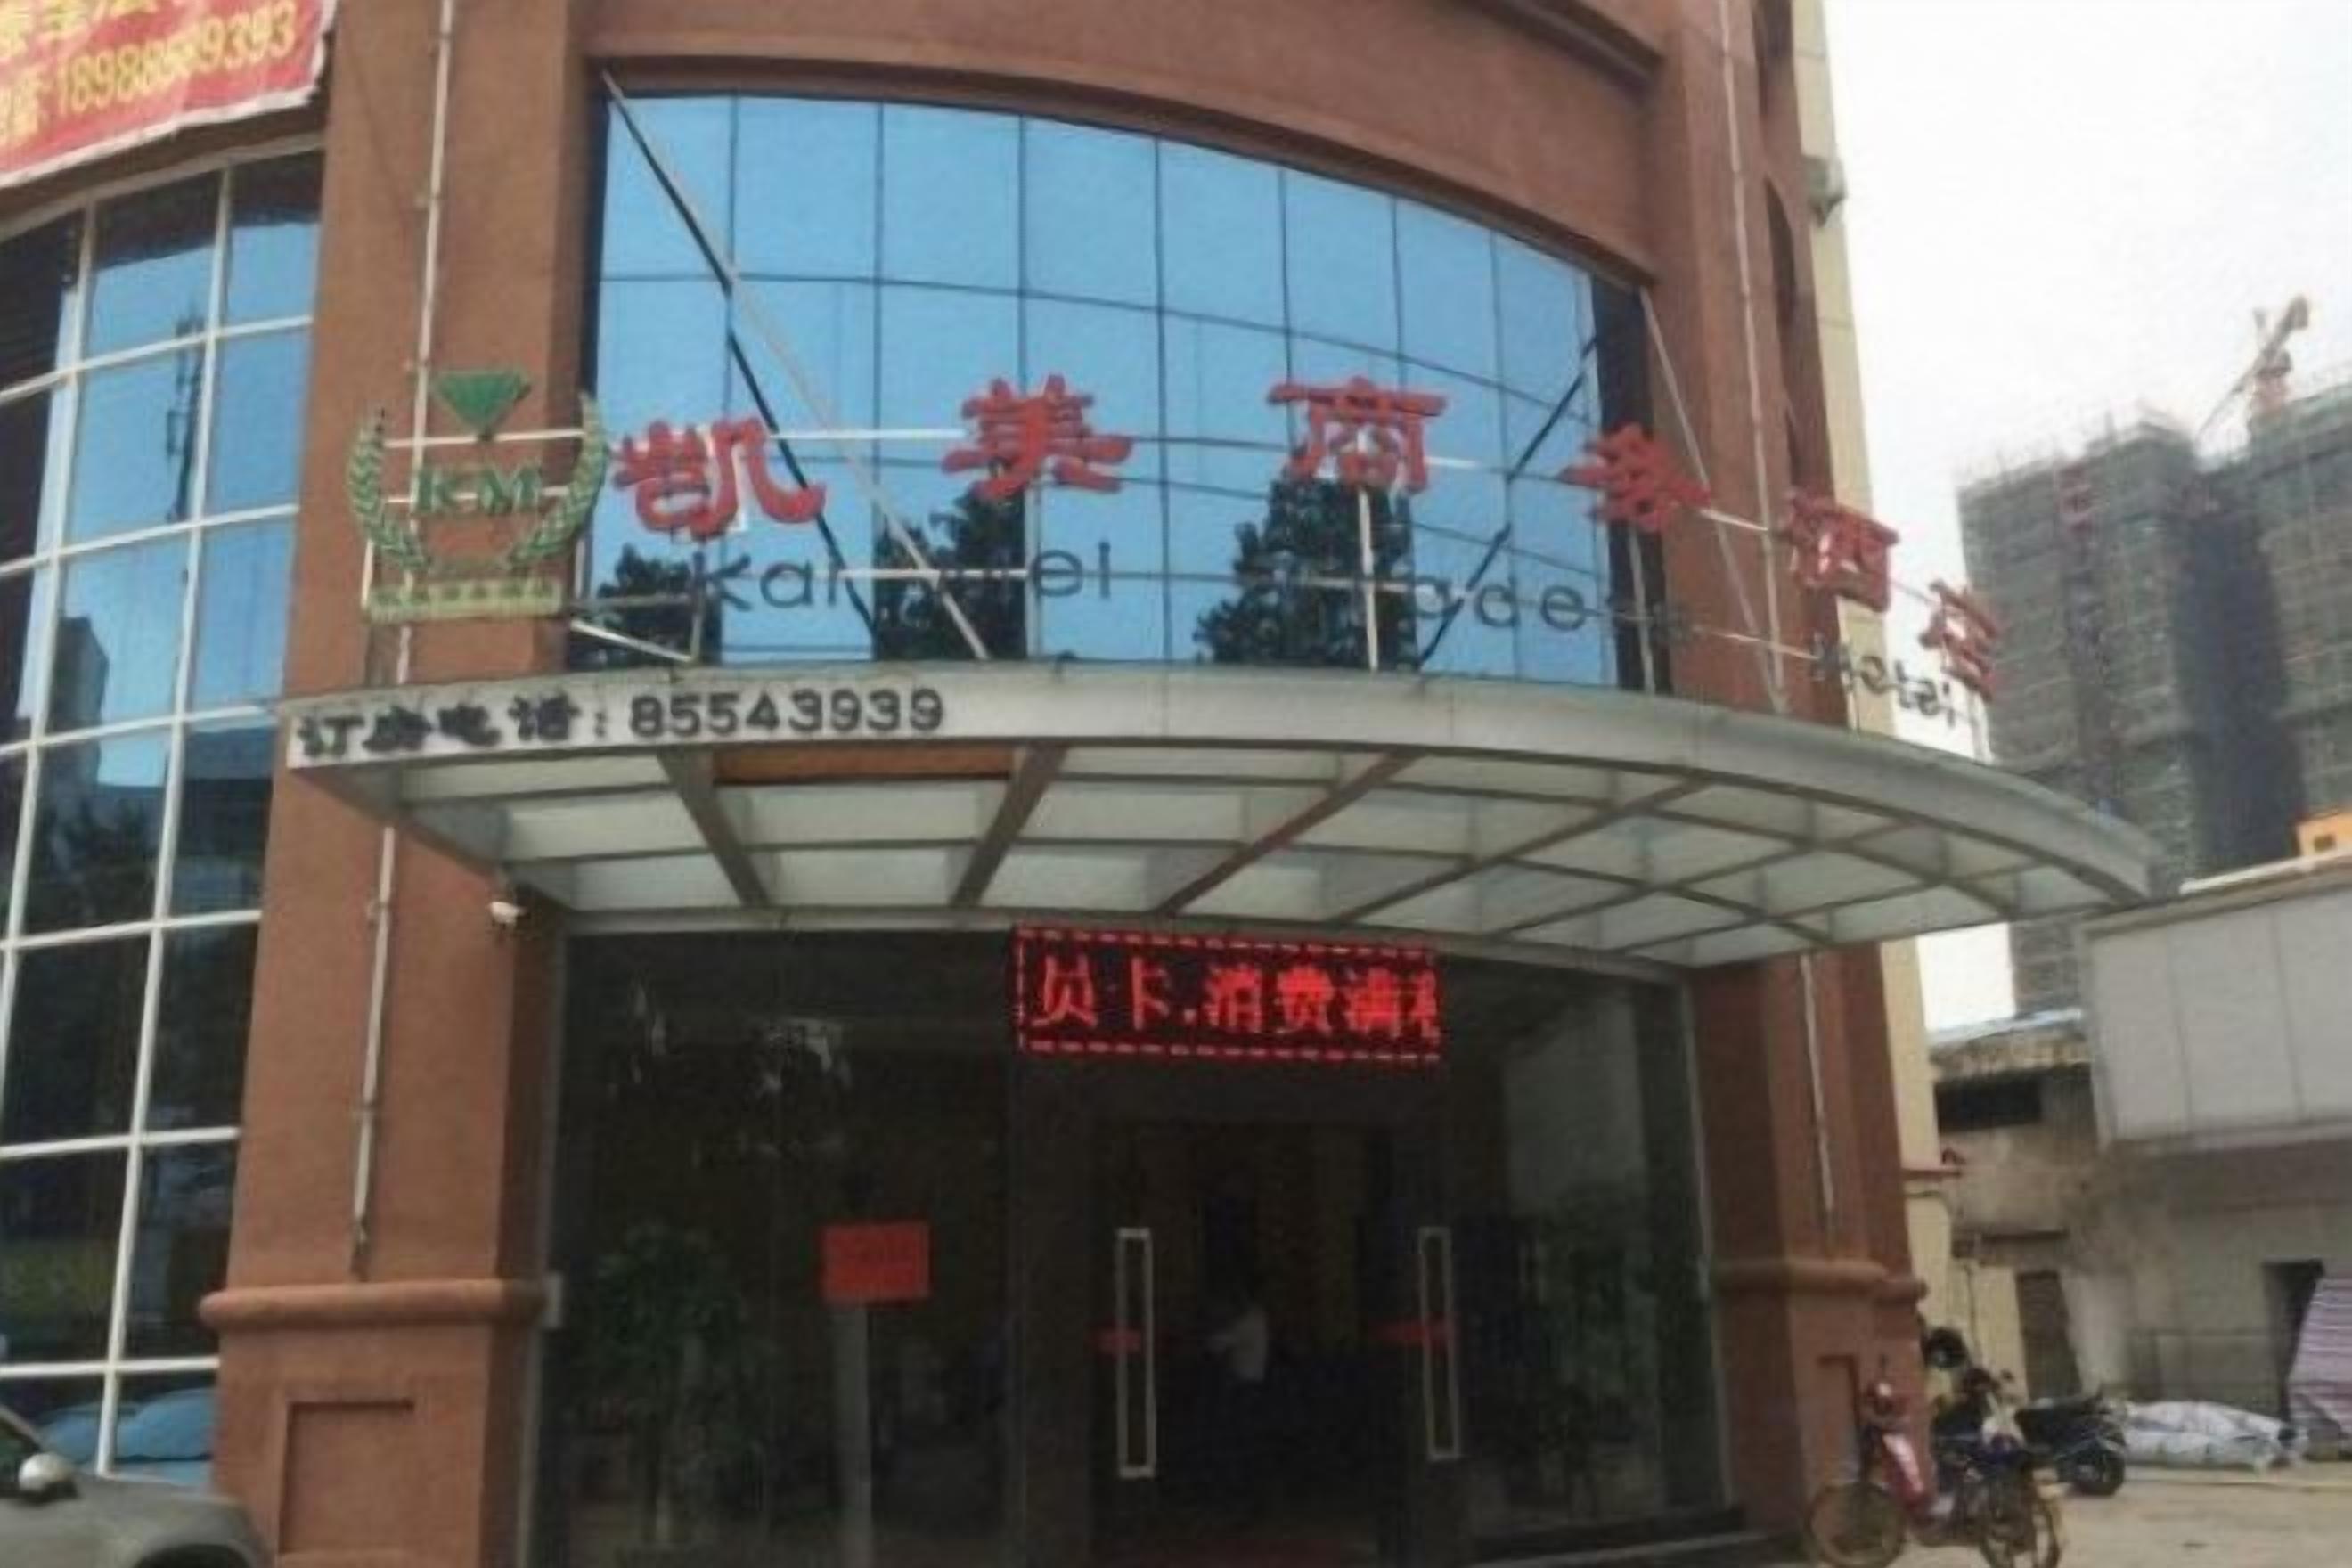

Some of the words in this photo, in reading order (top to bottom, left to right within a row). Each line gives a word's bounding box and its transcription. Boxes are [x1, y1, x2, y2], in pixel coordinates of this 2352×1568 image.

[609, 370, 1996, 704] 凯美商务酒店
